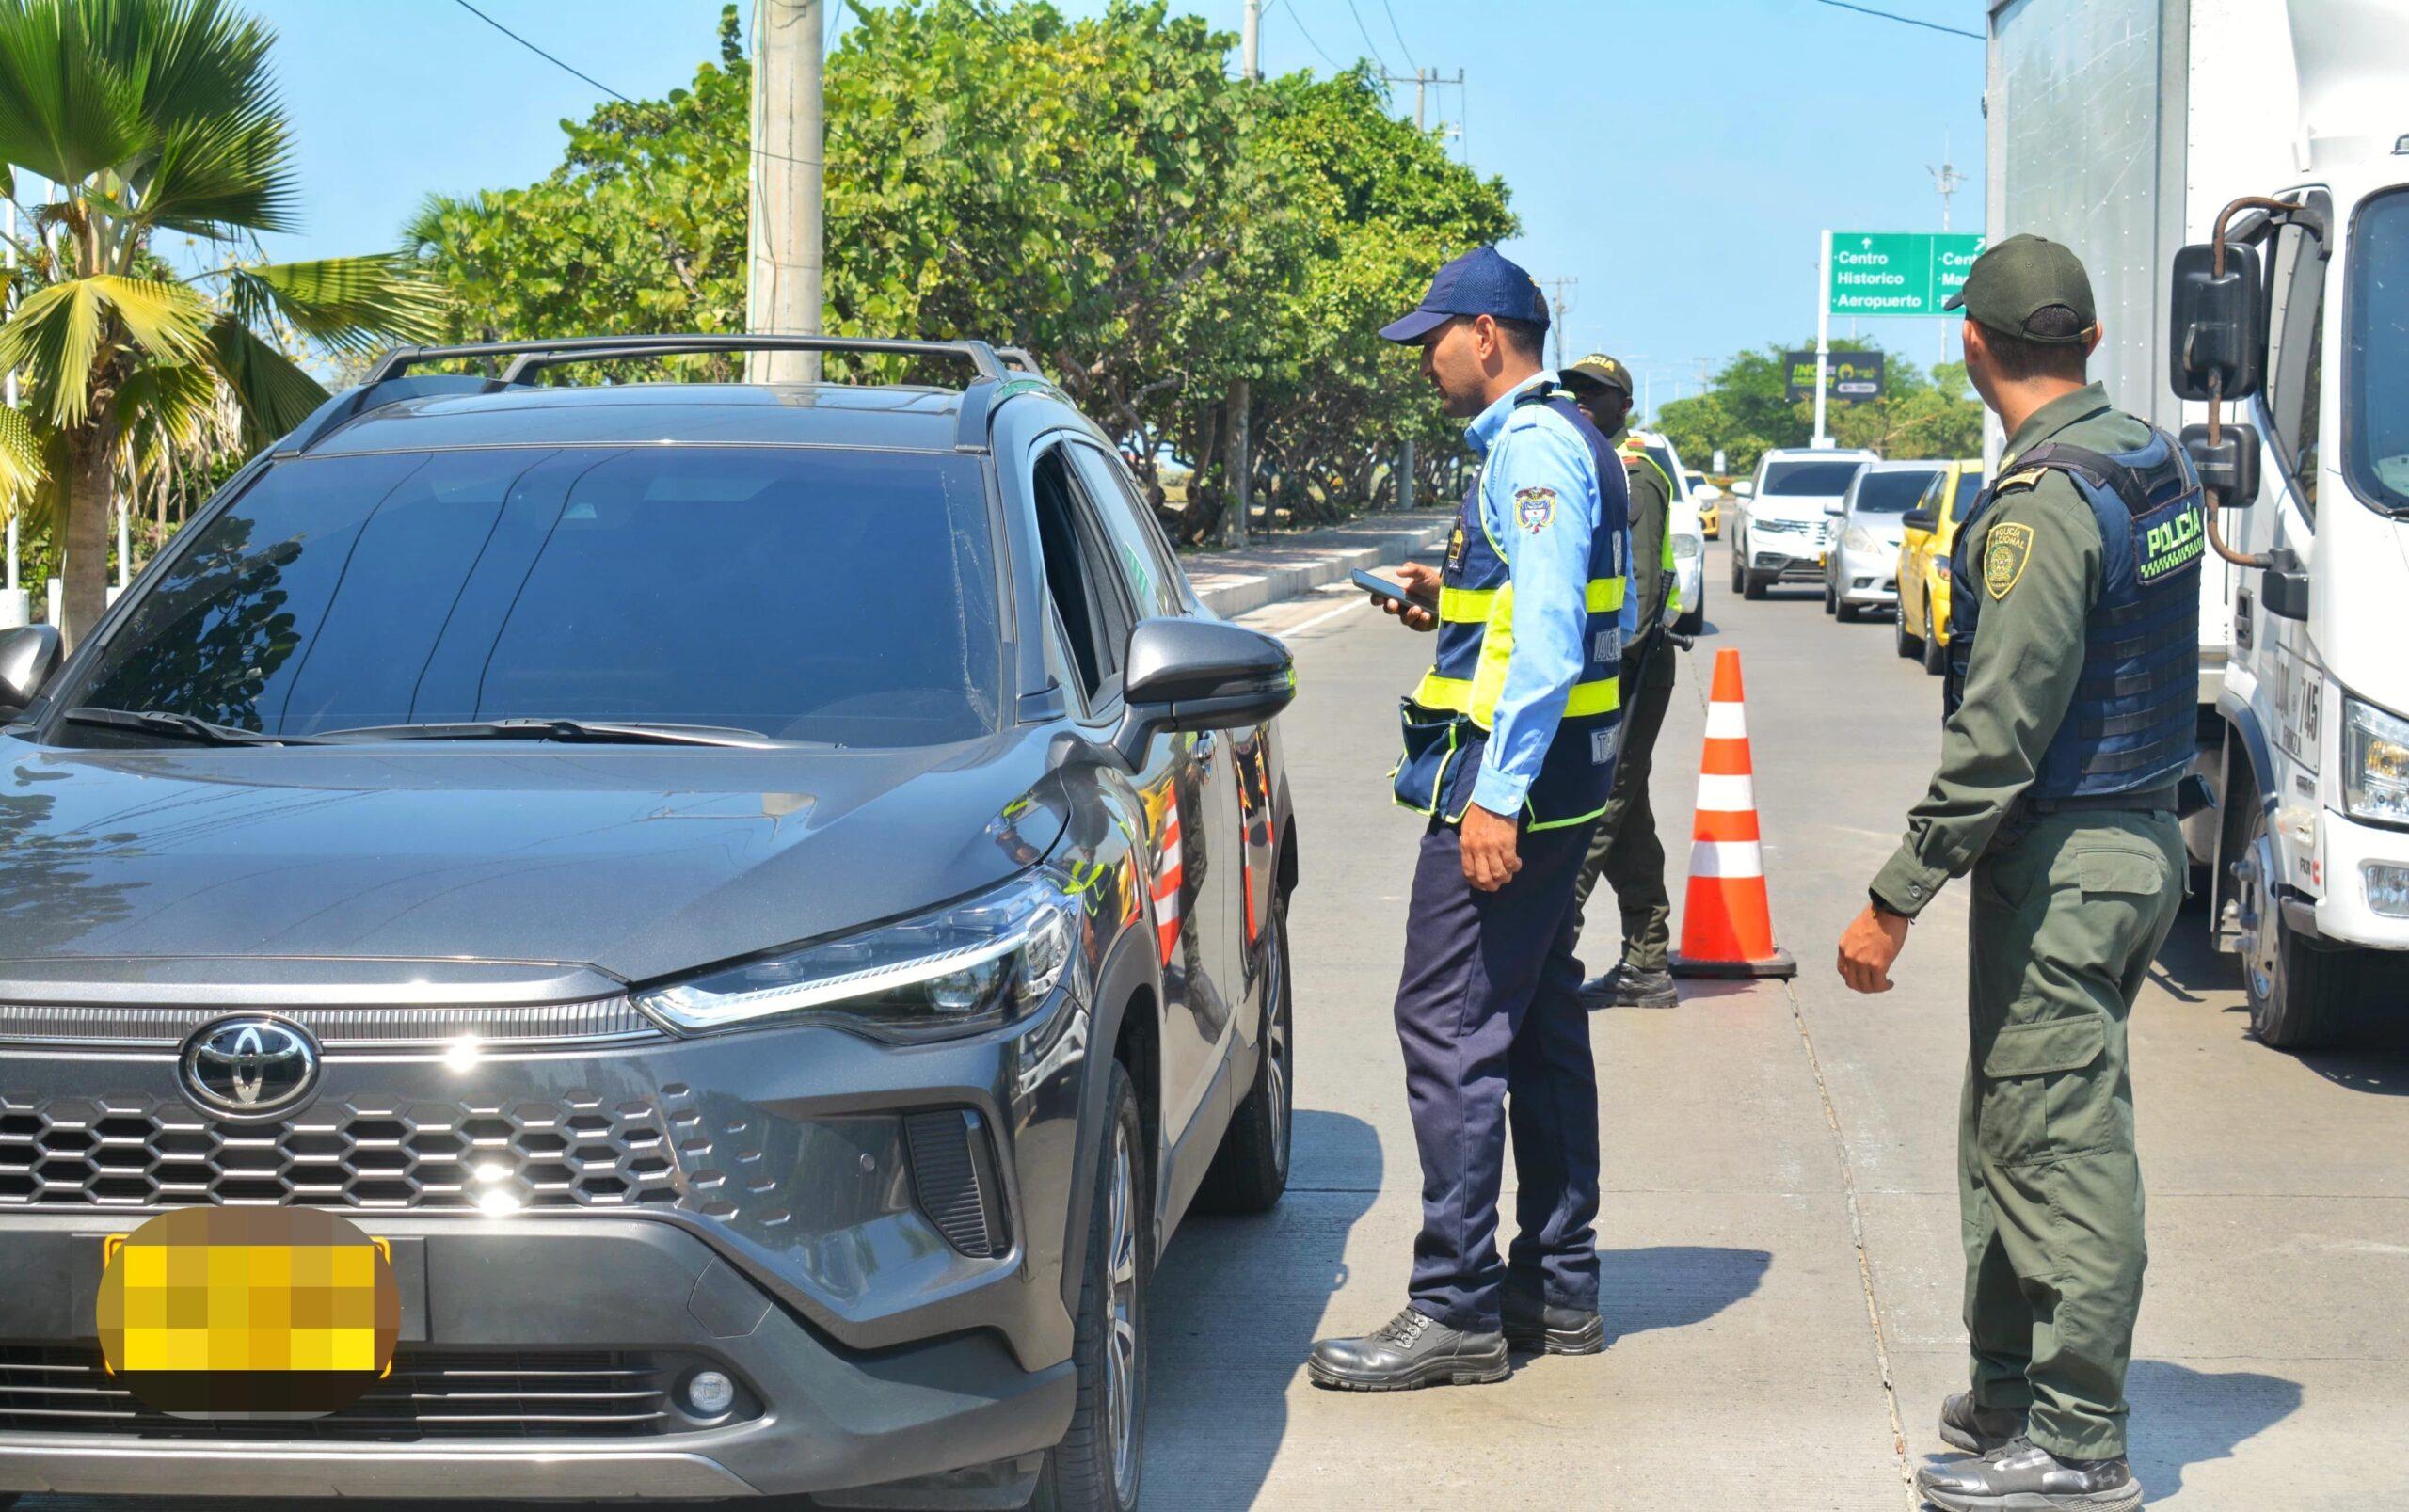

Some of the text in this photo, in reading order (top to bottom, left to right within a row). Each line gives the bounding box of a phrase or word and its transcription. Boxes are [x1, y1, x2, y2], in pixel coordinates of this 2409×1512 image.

[1838, 250, 1888, 265] Centro
[1837, 271, 1904, 285] Historico
[1837, 294, 1922, 310] Aeropuerto
[2146, 501, 2201, 558] POLICÍA
[2300, 676, 2318, 742] 745
